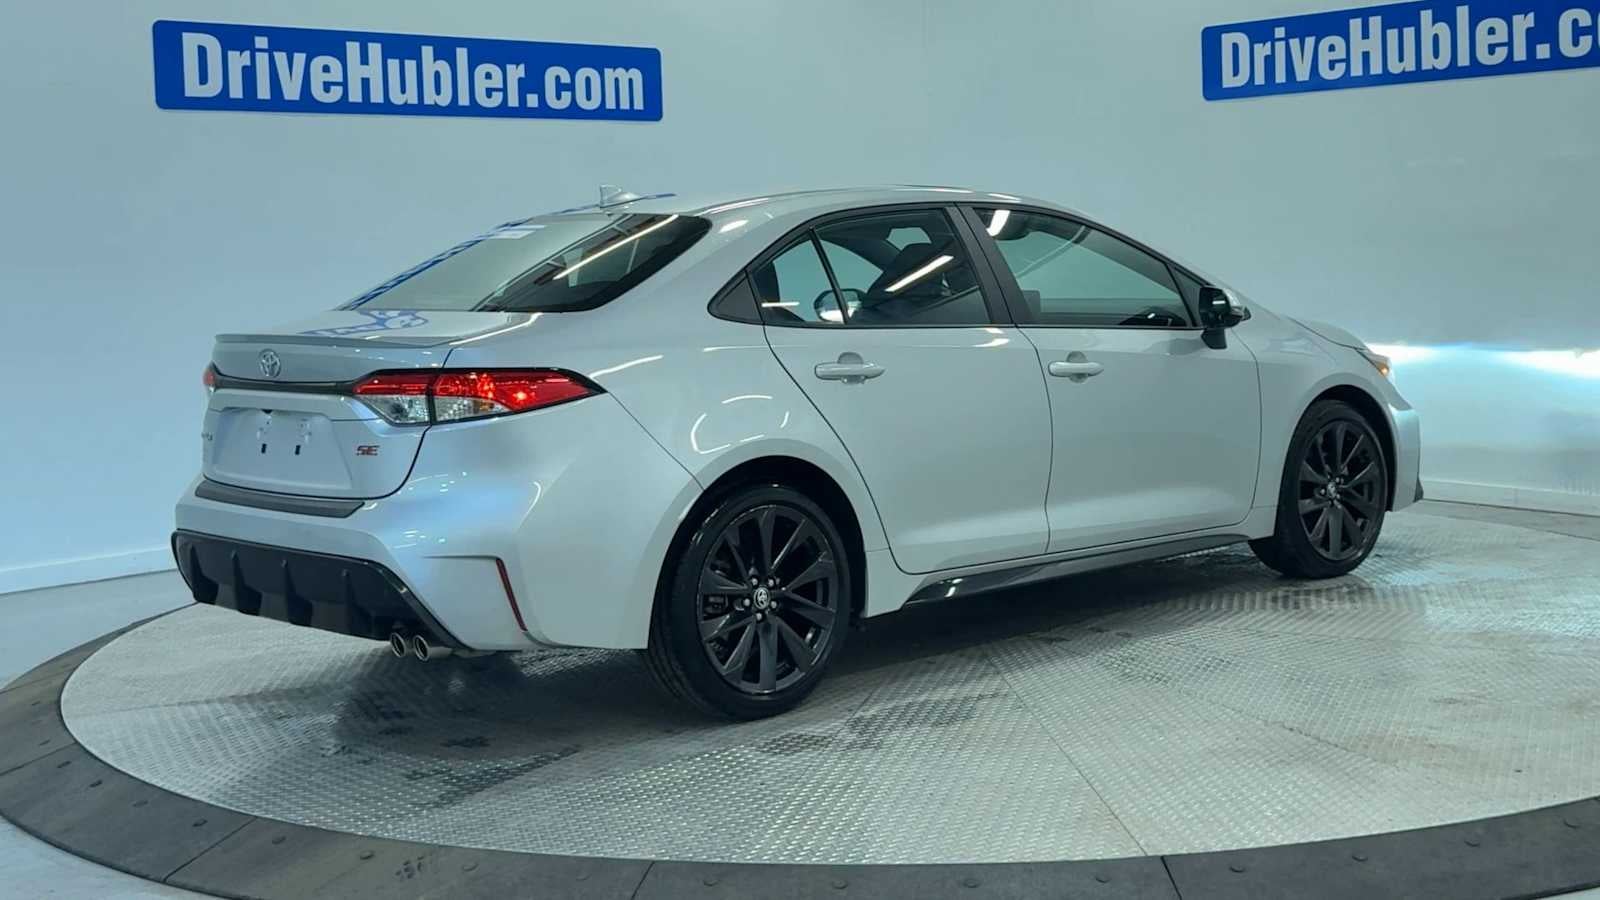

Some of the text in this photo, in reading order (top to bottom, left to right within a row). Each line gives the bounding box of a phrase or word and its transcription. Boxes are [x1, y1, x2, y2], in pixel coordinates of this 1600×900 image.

[181, 31, 645, 110] DriveHubler.com
[1221, 5, 1600, 89] DriveHubler.c
[356, 445, 380, 456] SE
